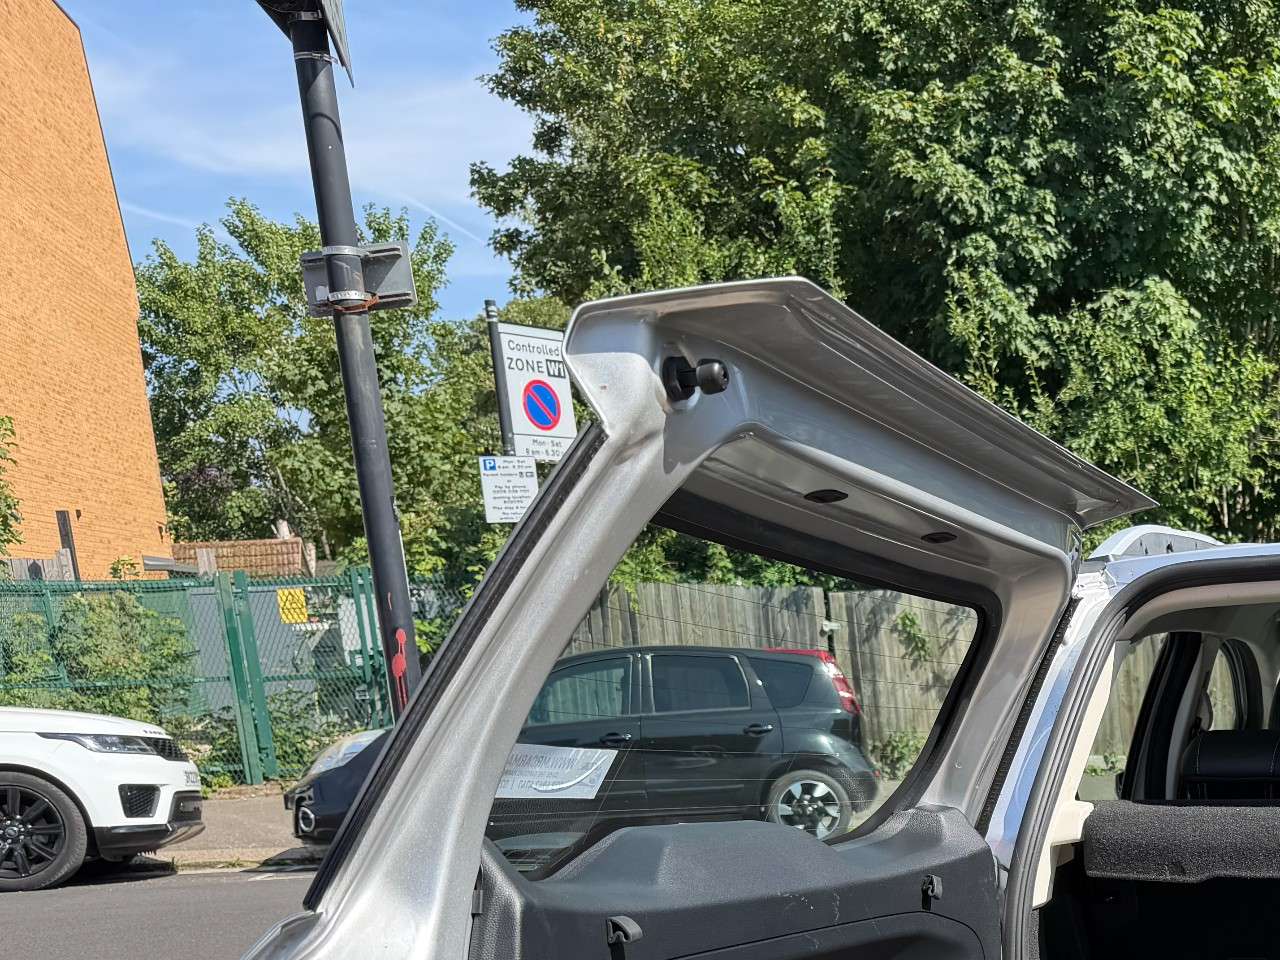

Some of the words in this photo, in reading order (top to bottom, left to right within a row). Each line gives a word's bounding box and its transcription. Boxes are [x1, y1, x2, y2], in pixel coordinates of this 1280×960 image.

[507, 339, 560, 357] Controlled
[506, 356, 544, 374] ZONE
[547, 359, 566, 378] W1
